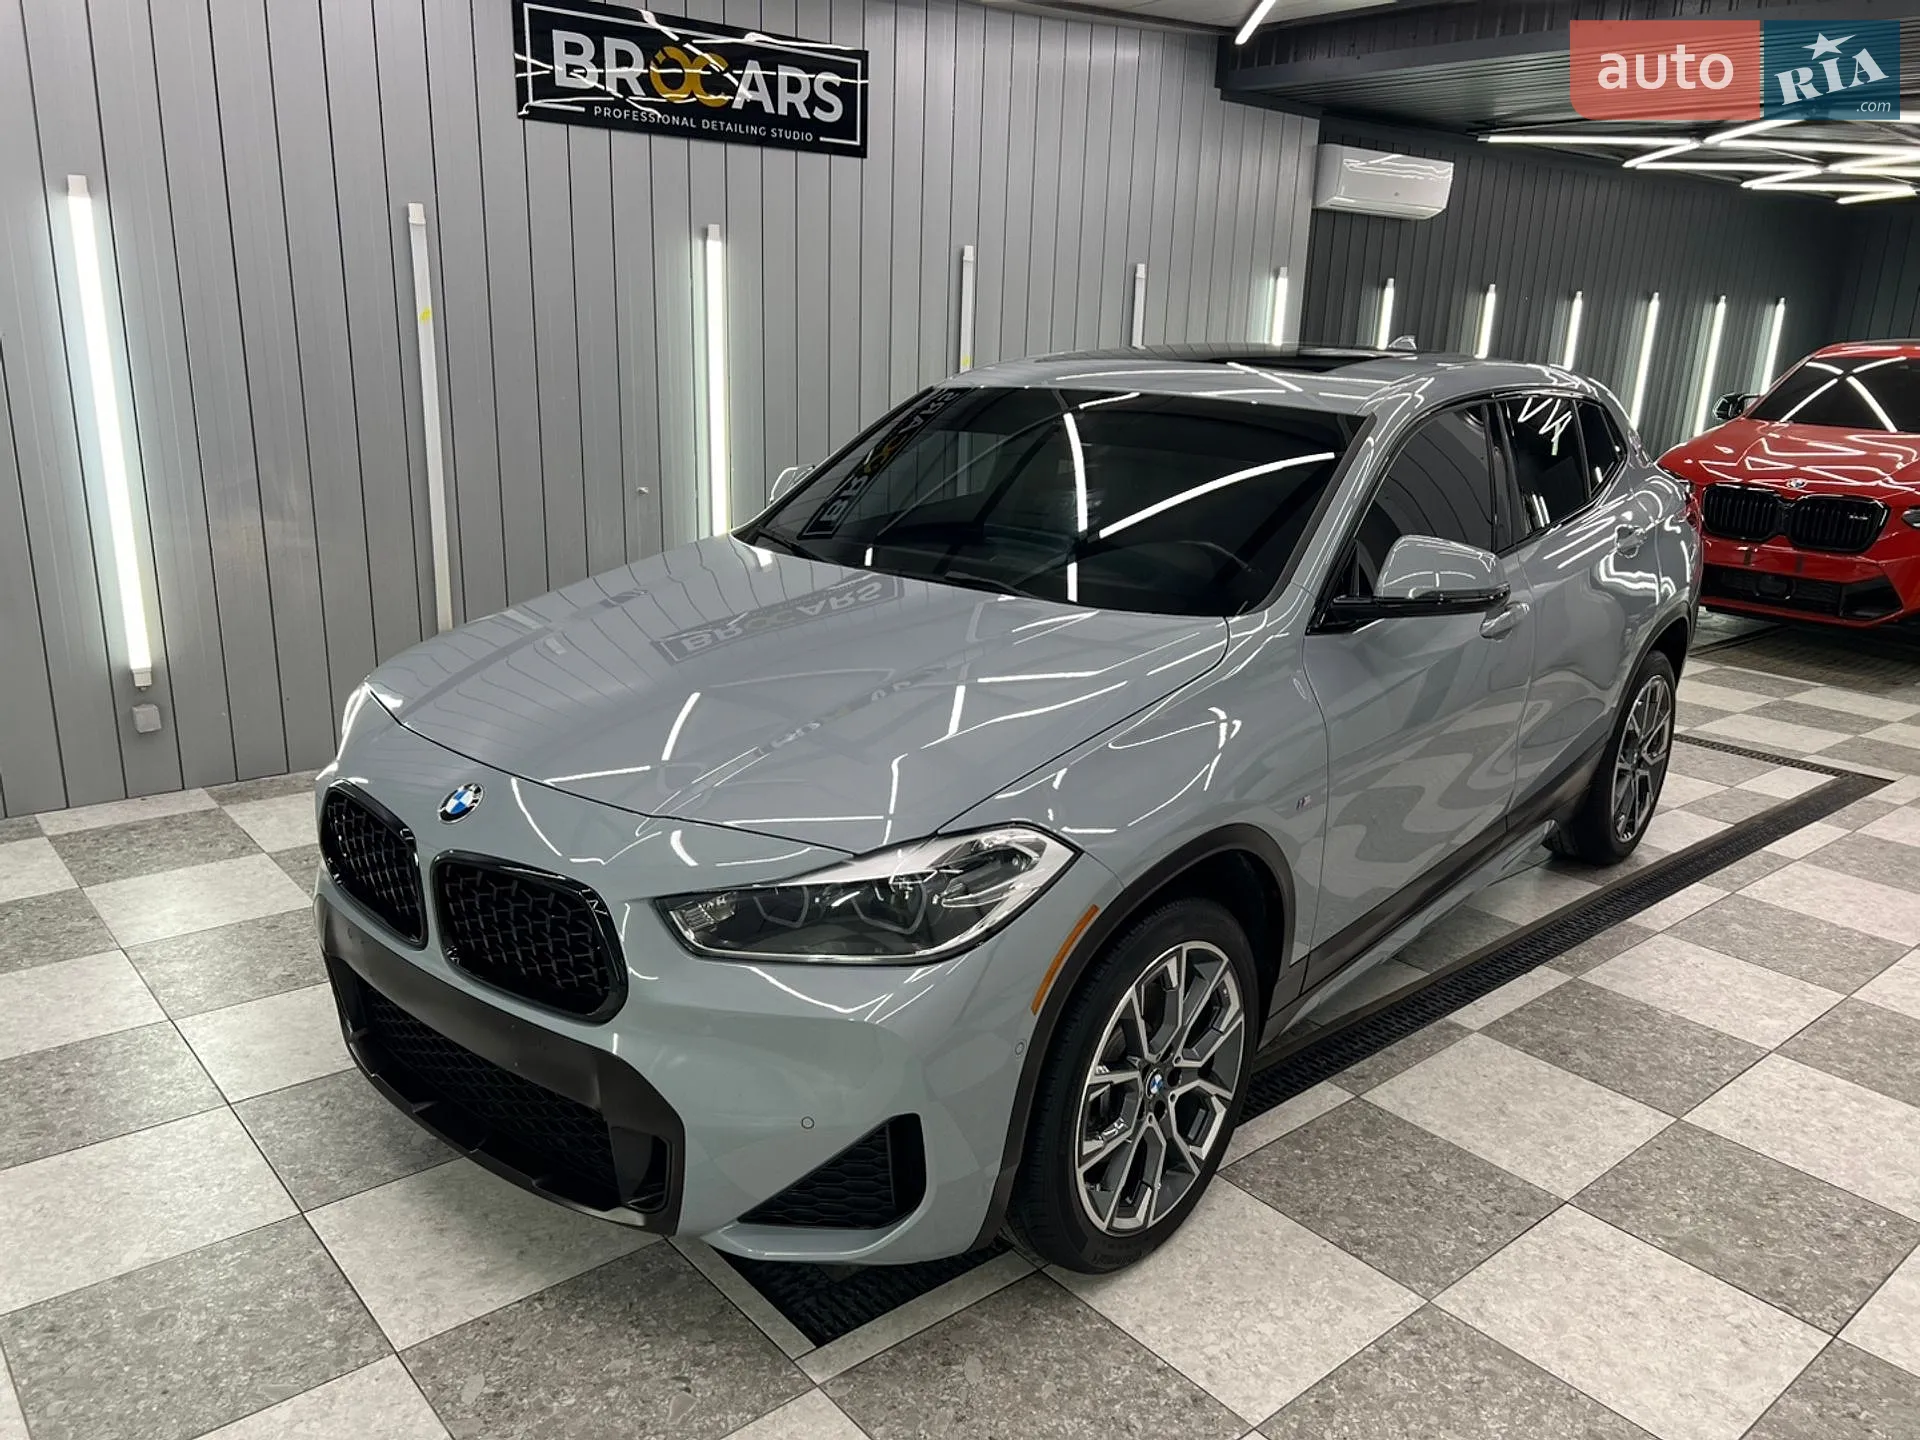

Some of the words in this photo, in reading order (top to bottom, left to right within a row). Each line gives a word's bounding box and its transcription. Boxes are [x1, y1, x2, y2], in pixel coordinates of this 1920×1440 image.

[594, 105, 697, 129] PROFESSIONAL
[701, 118, 767, 136] DETAILING
[770, 128, 813, 142] STUDIO
